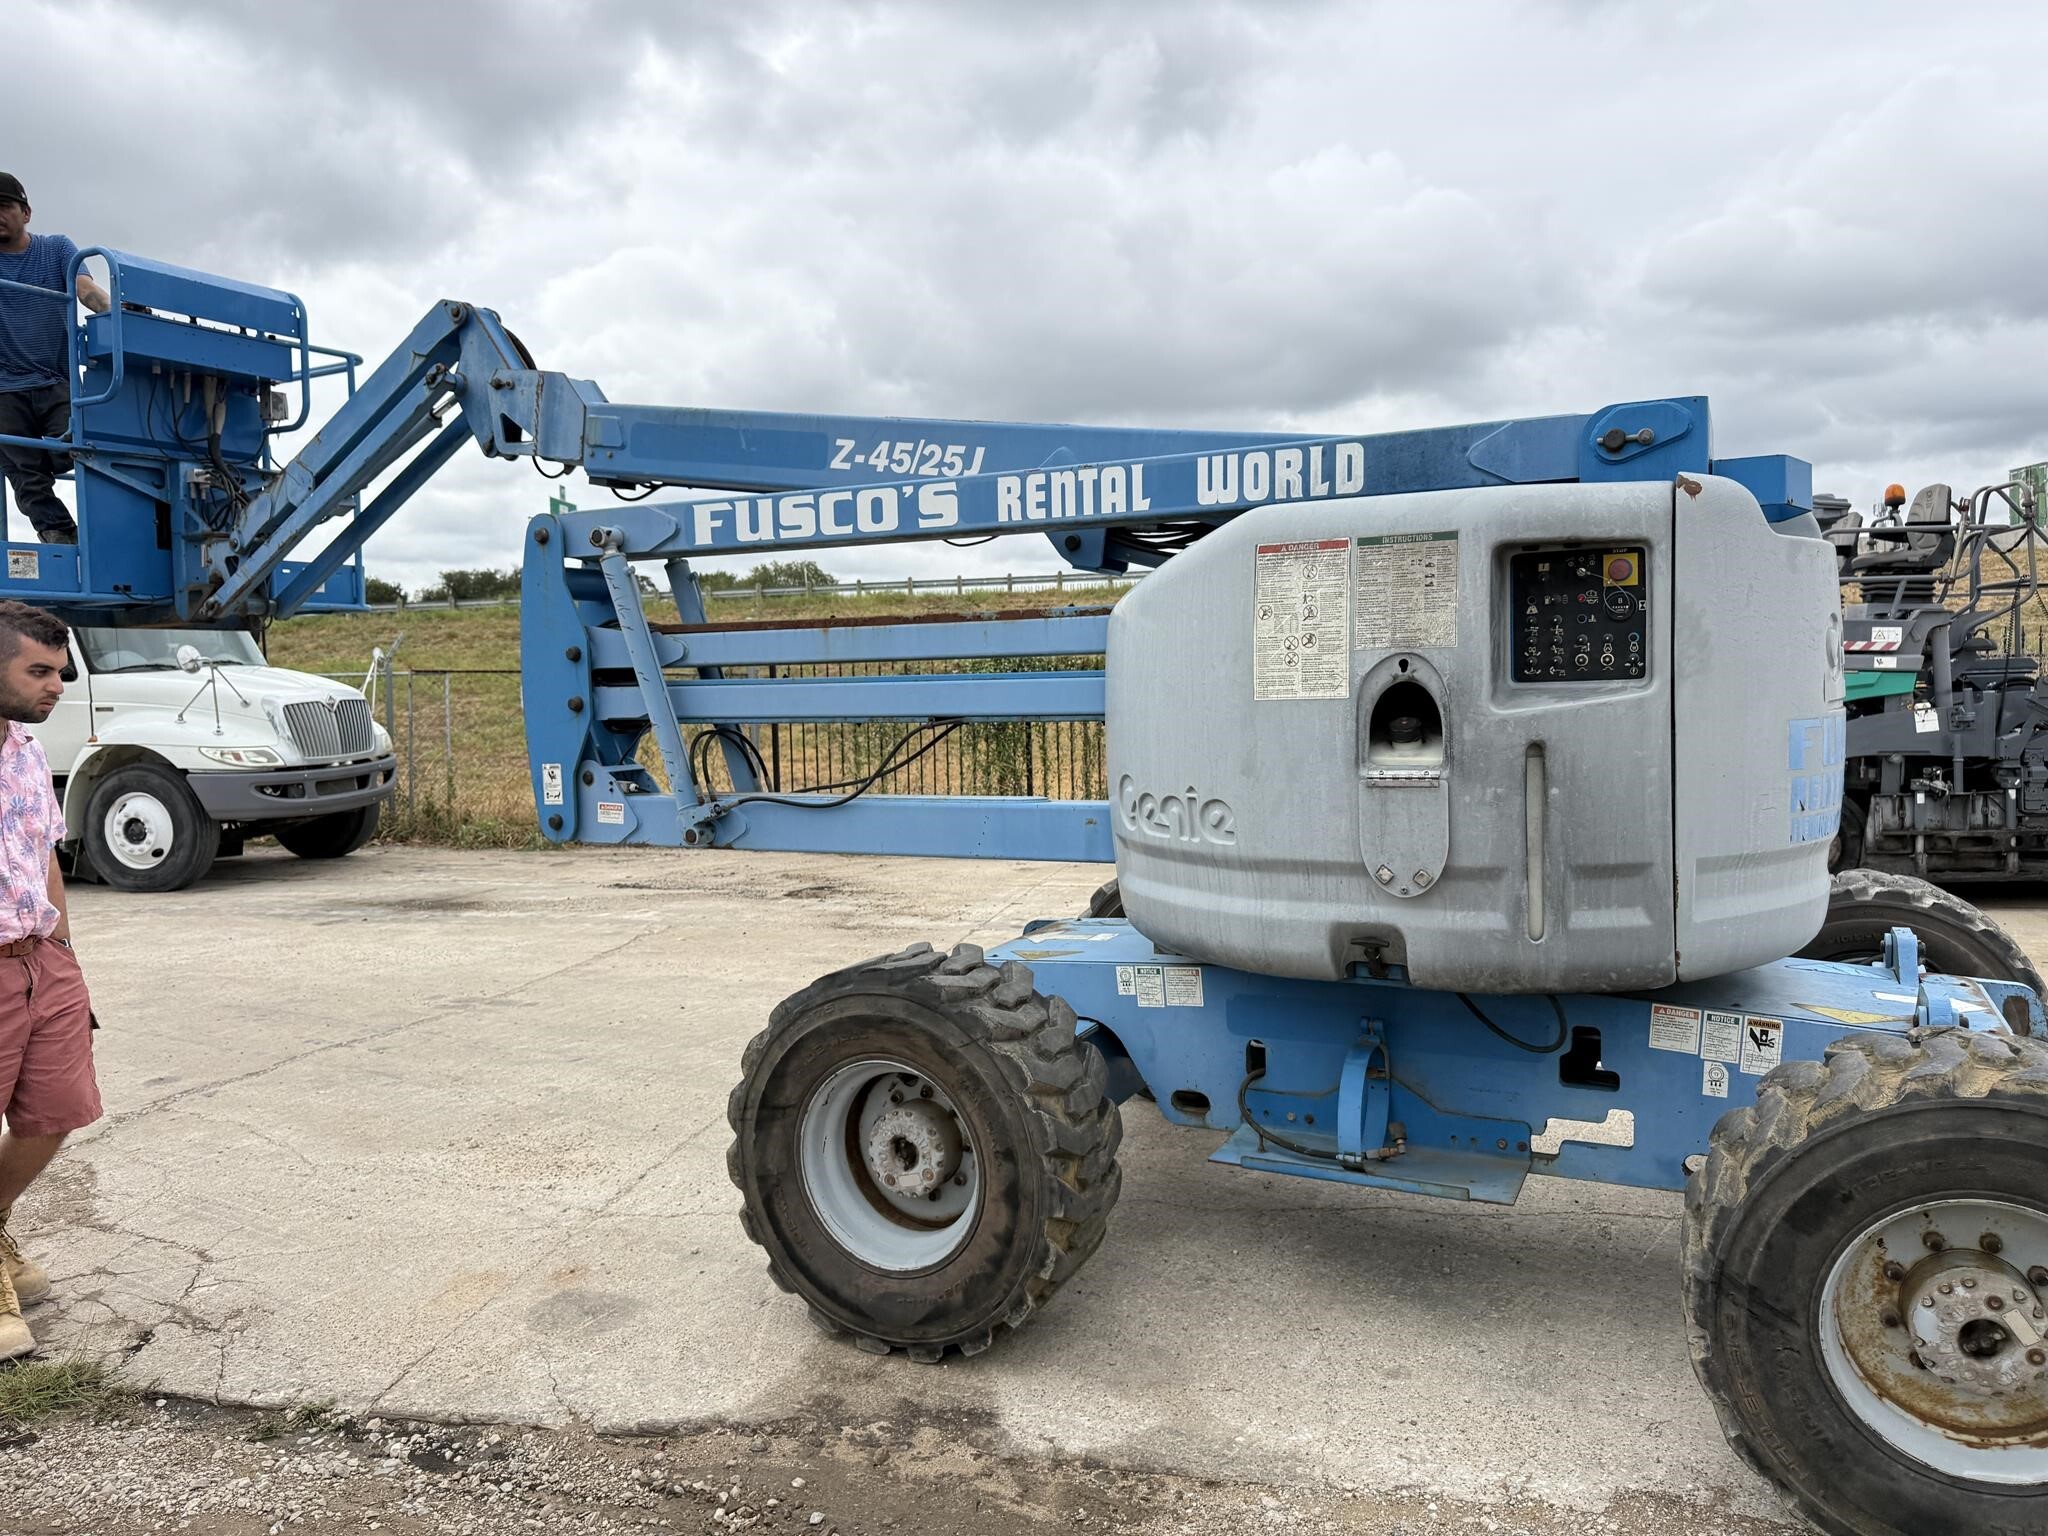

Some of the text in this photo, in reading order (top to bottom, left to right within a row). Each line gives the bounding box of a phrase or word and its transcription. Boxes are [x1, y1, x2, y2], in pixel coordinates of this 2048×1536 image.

[829, 438, 986, 477] Z-45/25J
[692, 442, 1364, 546] FUSCO'S RENTAL WORLD
[1382, 533, 1433, 544] INSTRUCTIONS
[1288, 543, 1320, 552] DANGER
[1119, 773, 1237, 846] Genie
[1666, 1008, 1695, 1018] DANGER
[1711, 1015, 1735, 1024] NOTICE
[1752, 1020, 1780, 1029] WARNING
